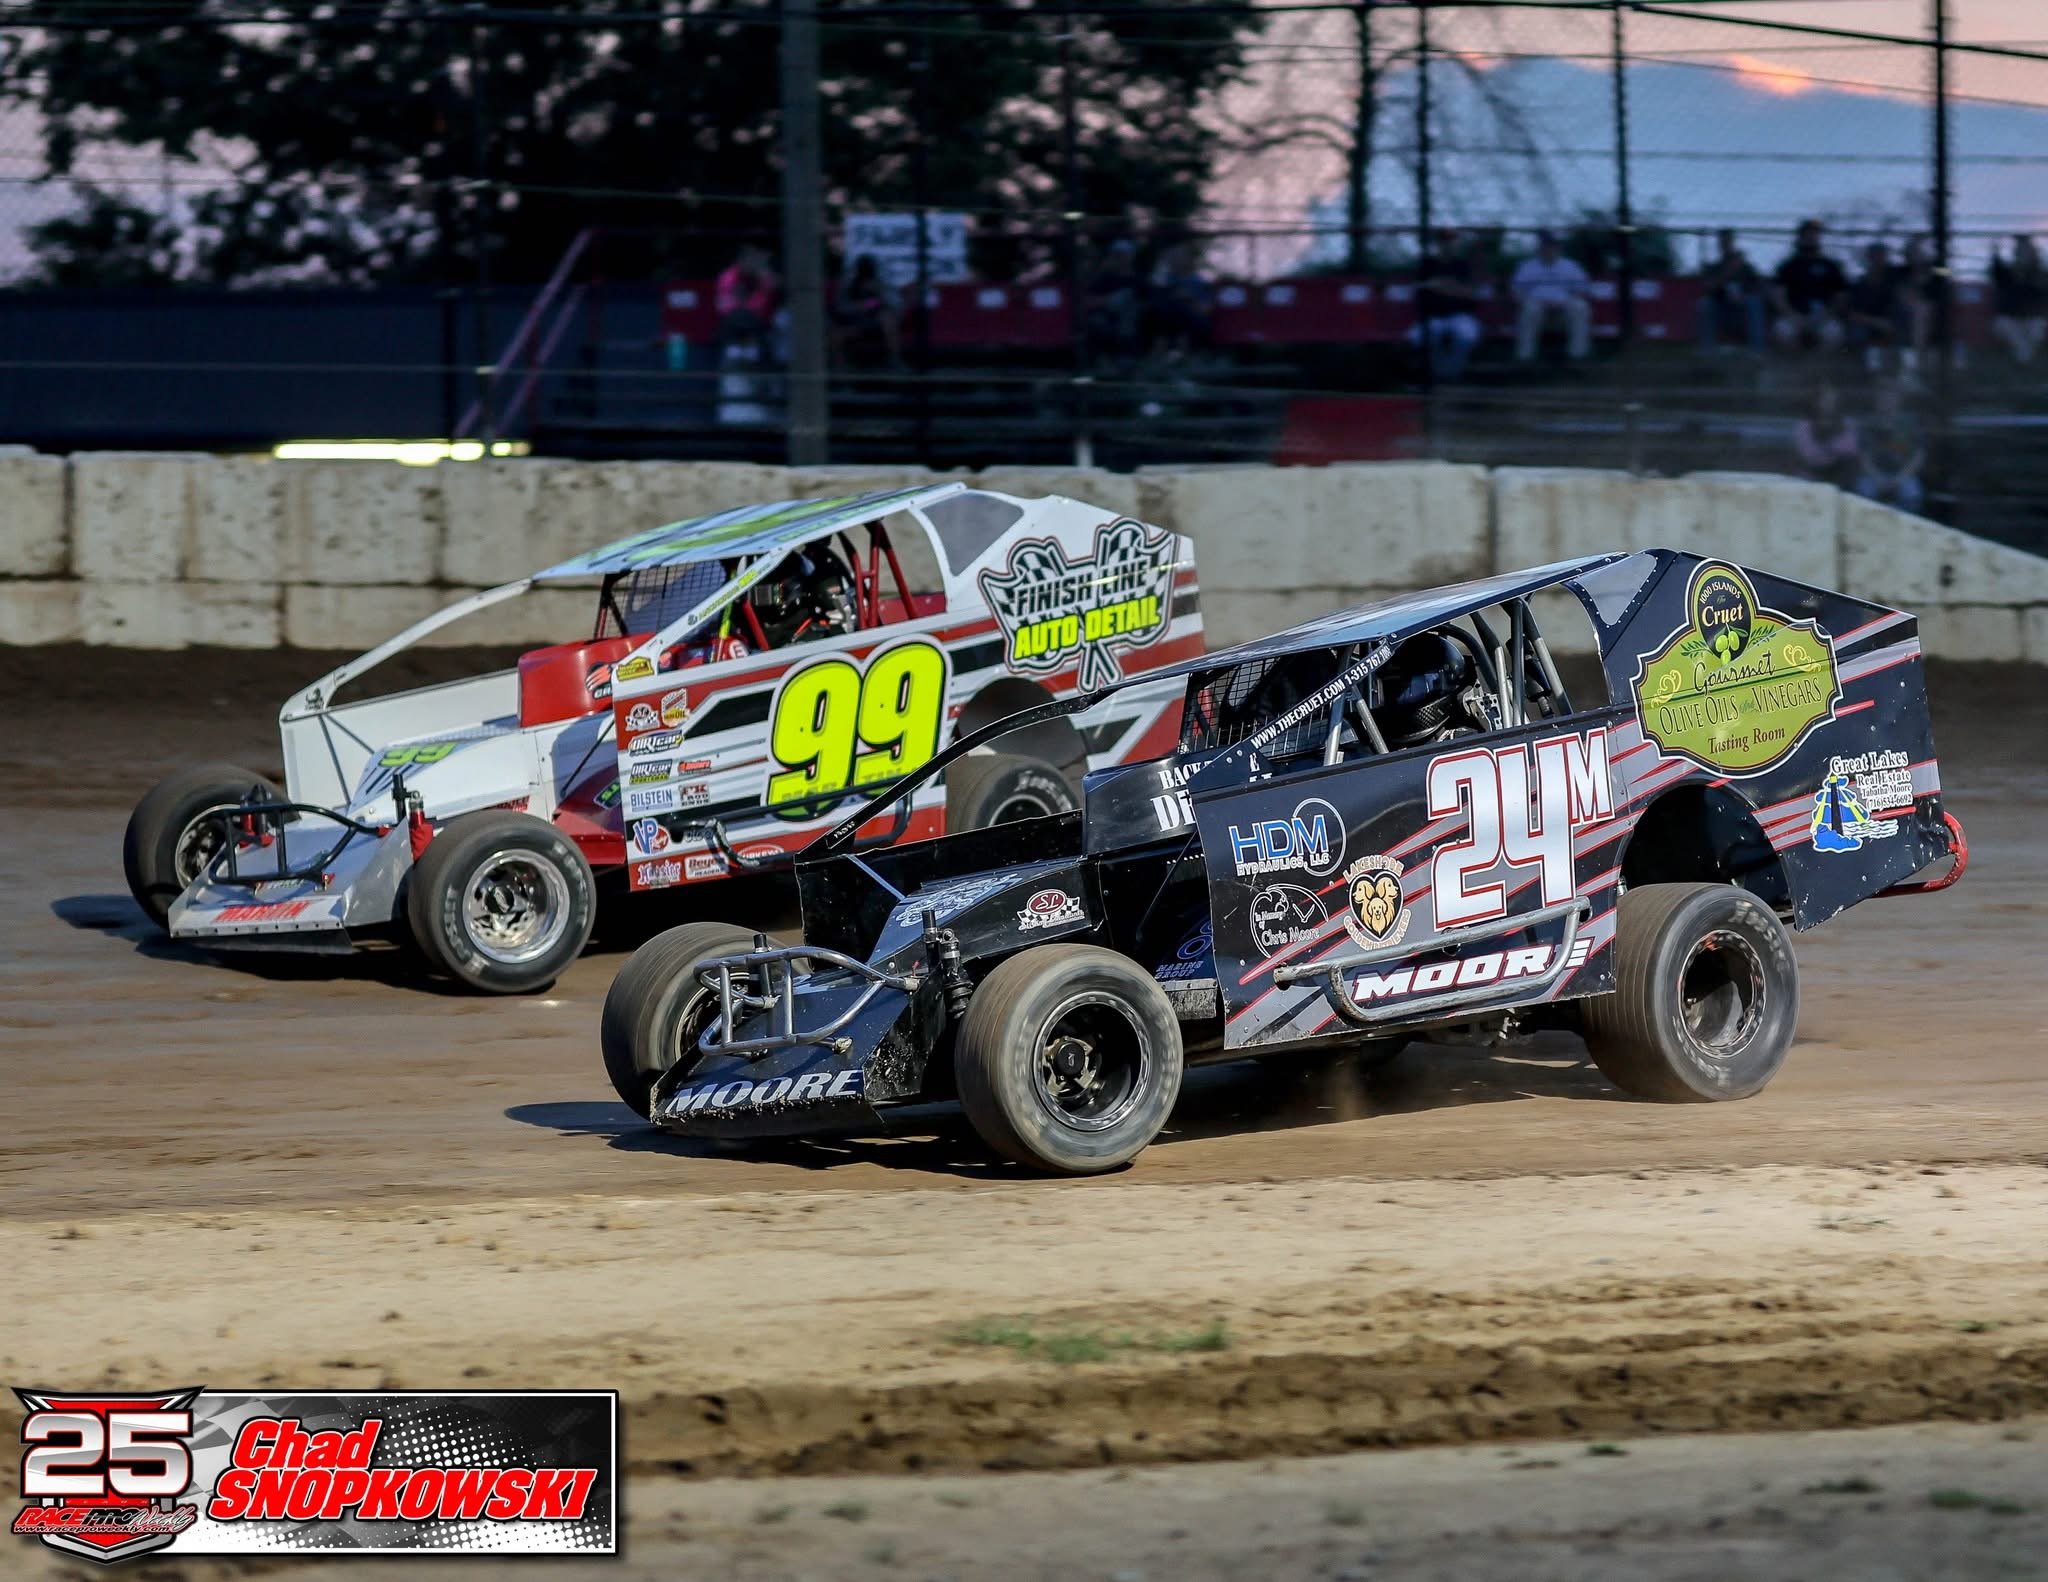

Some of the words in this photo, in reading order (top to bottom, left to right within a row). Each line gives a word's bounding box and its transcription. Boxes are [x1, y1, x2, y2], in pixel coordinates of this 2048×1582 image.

[1014, 572, 1093, 618] FINISH
[1100, 559, 1148, 596] LINE
[1699, 585, 1713, 604] 1000
[1711, 581, 1741, 599] ISLANDS
[1013, 613, 1080, 660] AUTO
[1083, 594, 1162, 642] DETAIL
[1701, 602, 1744, 627] Cruet
[1693, 650, 1775, 695] Gourmet
[1250, 680, 1345, 750] WWW.THECRUET.COM
[1345, 660, 1369, 685] 1-315
[1659, 703, 1703, 736] OLIVE
[1705, 695, 1739, 726] OILS
[1751, 677, 1823, 714] VINEGARS
[767, 642, 946, 822] 99
[1707, 733, 1750, 755] Tasting
[1752, 727, 1786, 745] Room
[1830, 753, 1869, 775] Great
[1868, 749, 1909, 771] Lakes
[1856, 773, 1881, 788] Real
[1880, 769, 1911, 785] Estate
[631, 788, 673, 808] BILSTEIN
[1888, 783, 1913, 796] Moore
[633, 818, 658, 856] VP
[1228, 815, 1331, 864] HDM
[1426, 727, 1615, 932] 24M
[1237, 858, 1309, 877] HYDRAULICS,
[1310, 853, 1330, 868] LLC
[1343, 855, 1405, 885] LAKESHORE
[1262, 928, 1288, 947] Chris
[1288, 926, 1320, 943] Moore
[1350, 937, 1596, 1002] MOORE
[664, 1069, 864, 1114] MOORE
